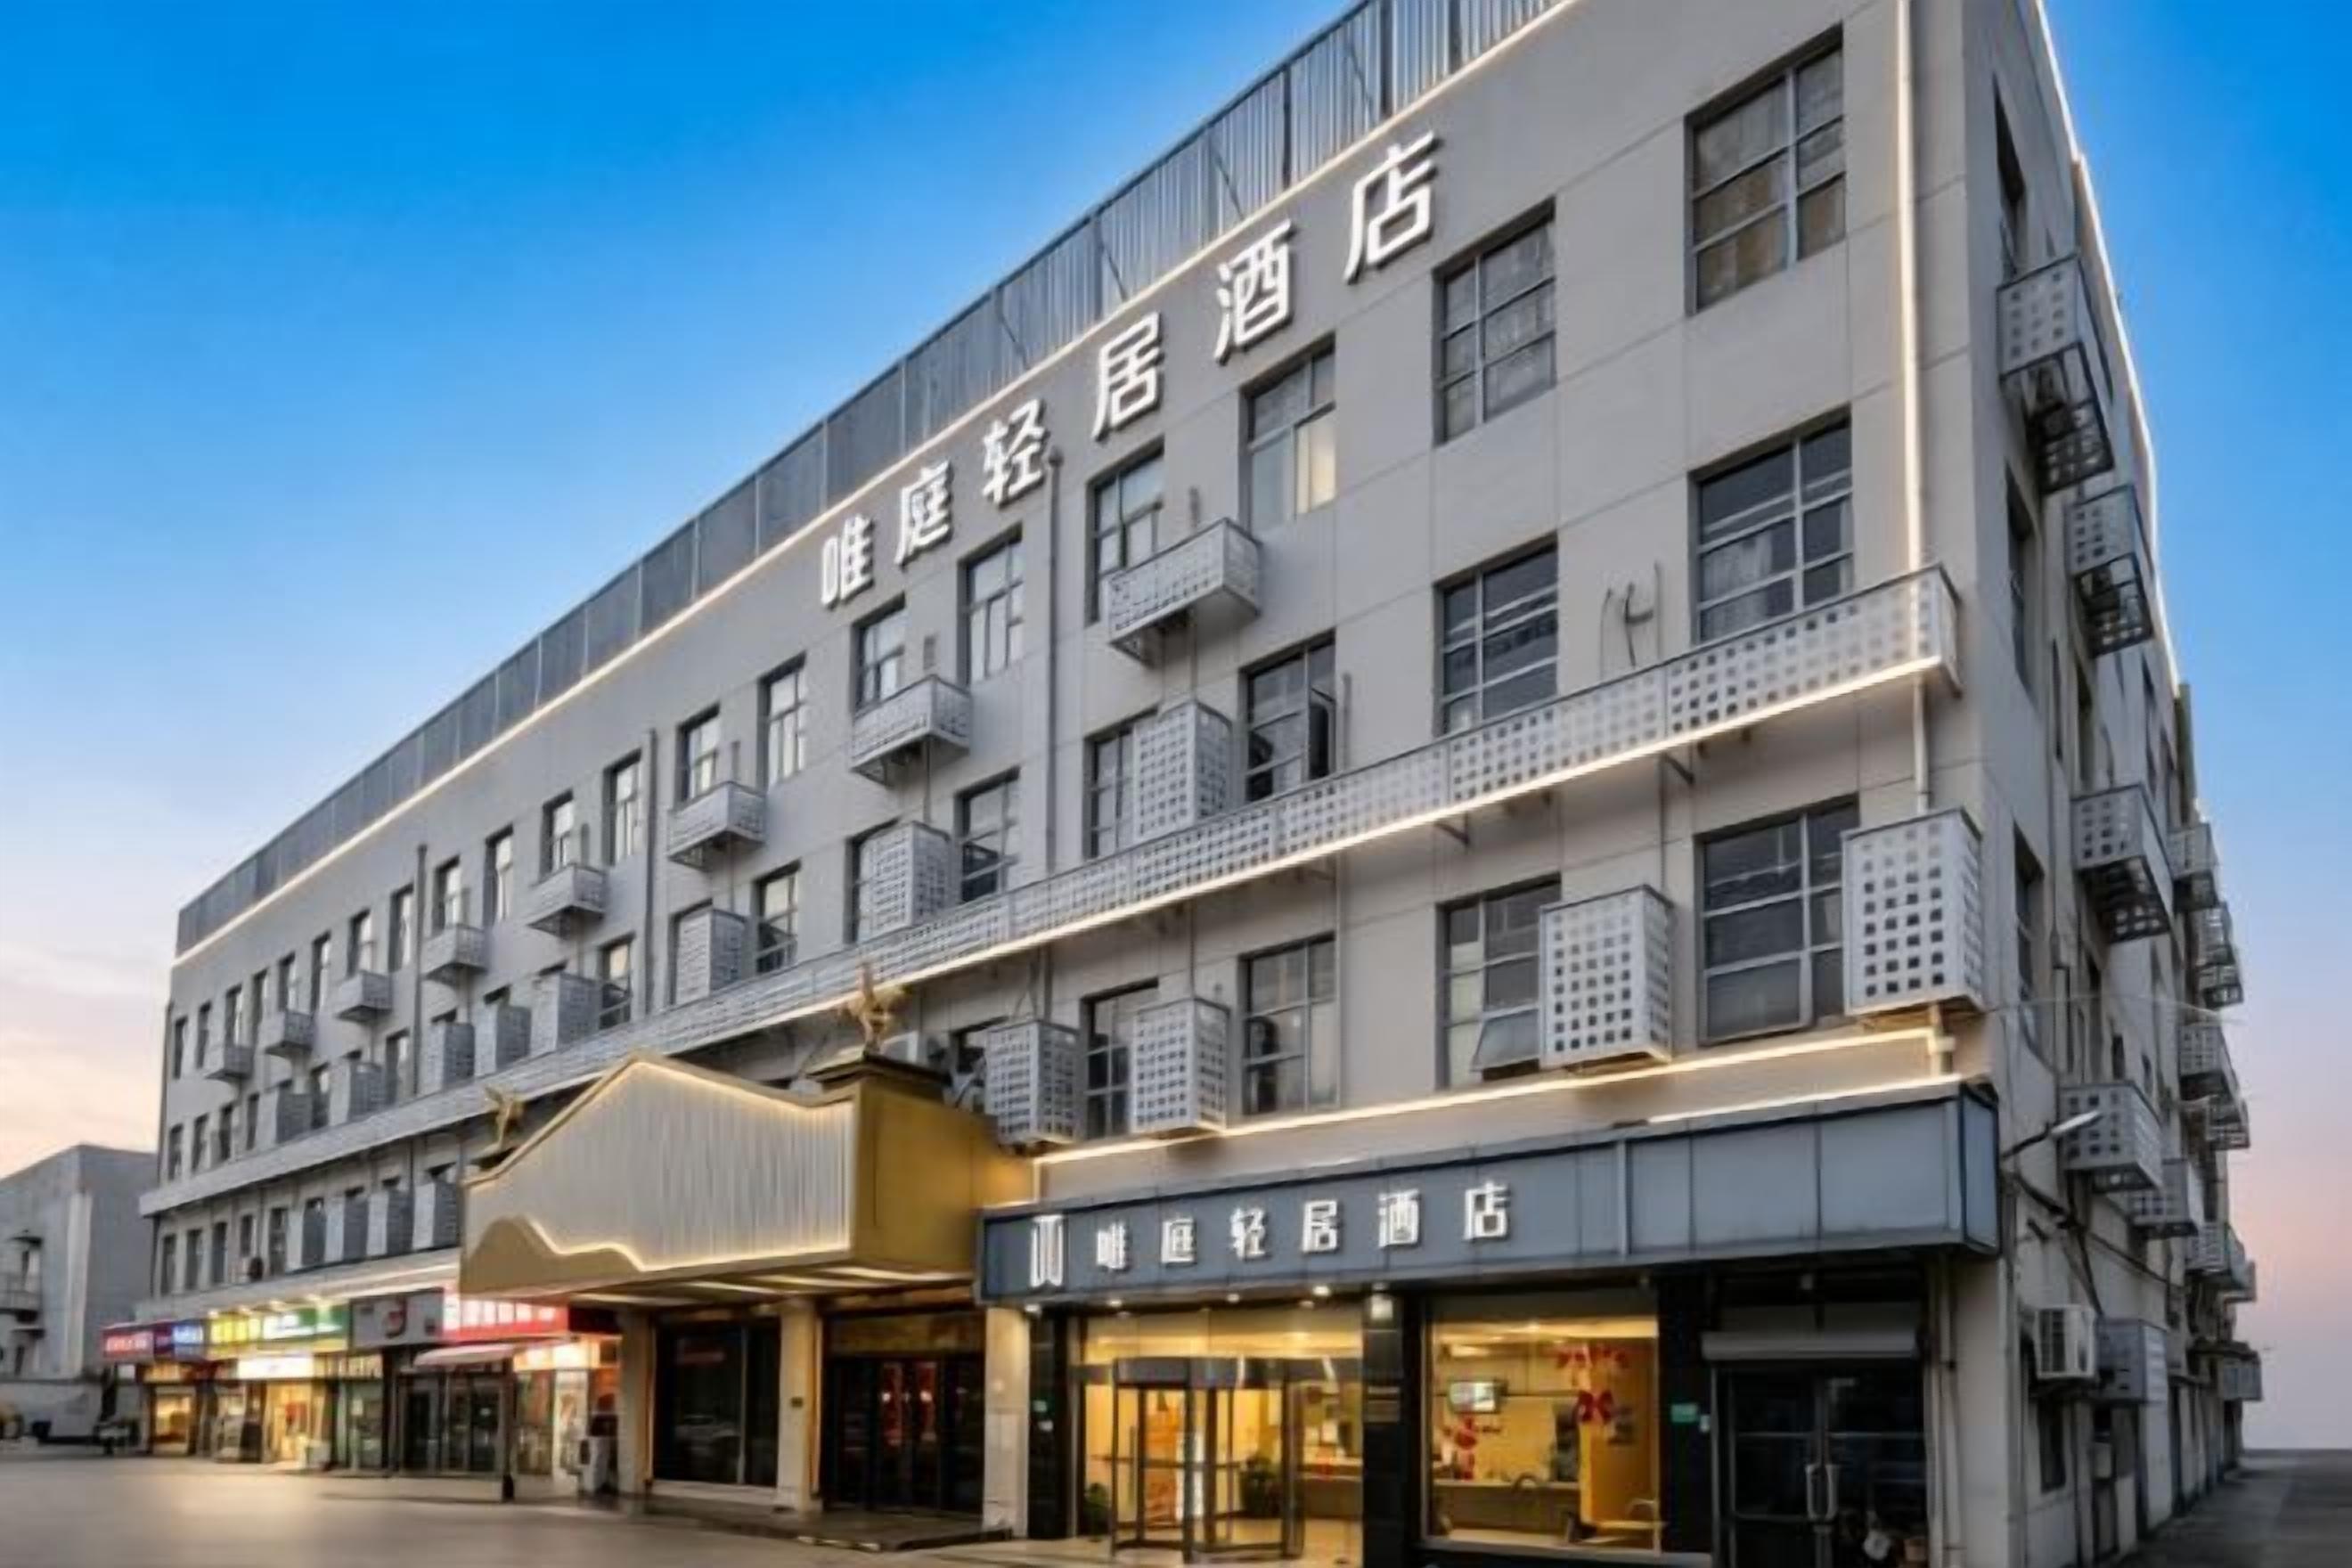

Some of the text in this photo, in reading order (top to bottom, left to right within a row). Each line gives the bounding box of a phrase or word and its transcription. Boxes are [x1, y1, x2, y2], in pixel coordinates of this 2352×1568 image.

[821, 131, 1437, 607] 唯庭轻居酒店
[1096, 1181, 1510, 1270] 唯庭轻居酒店
